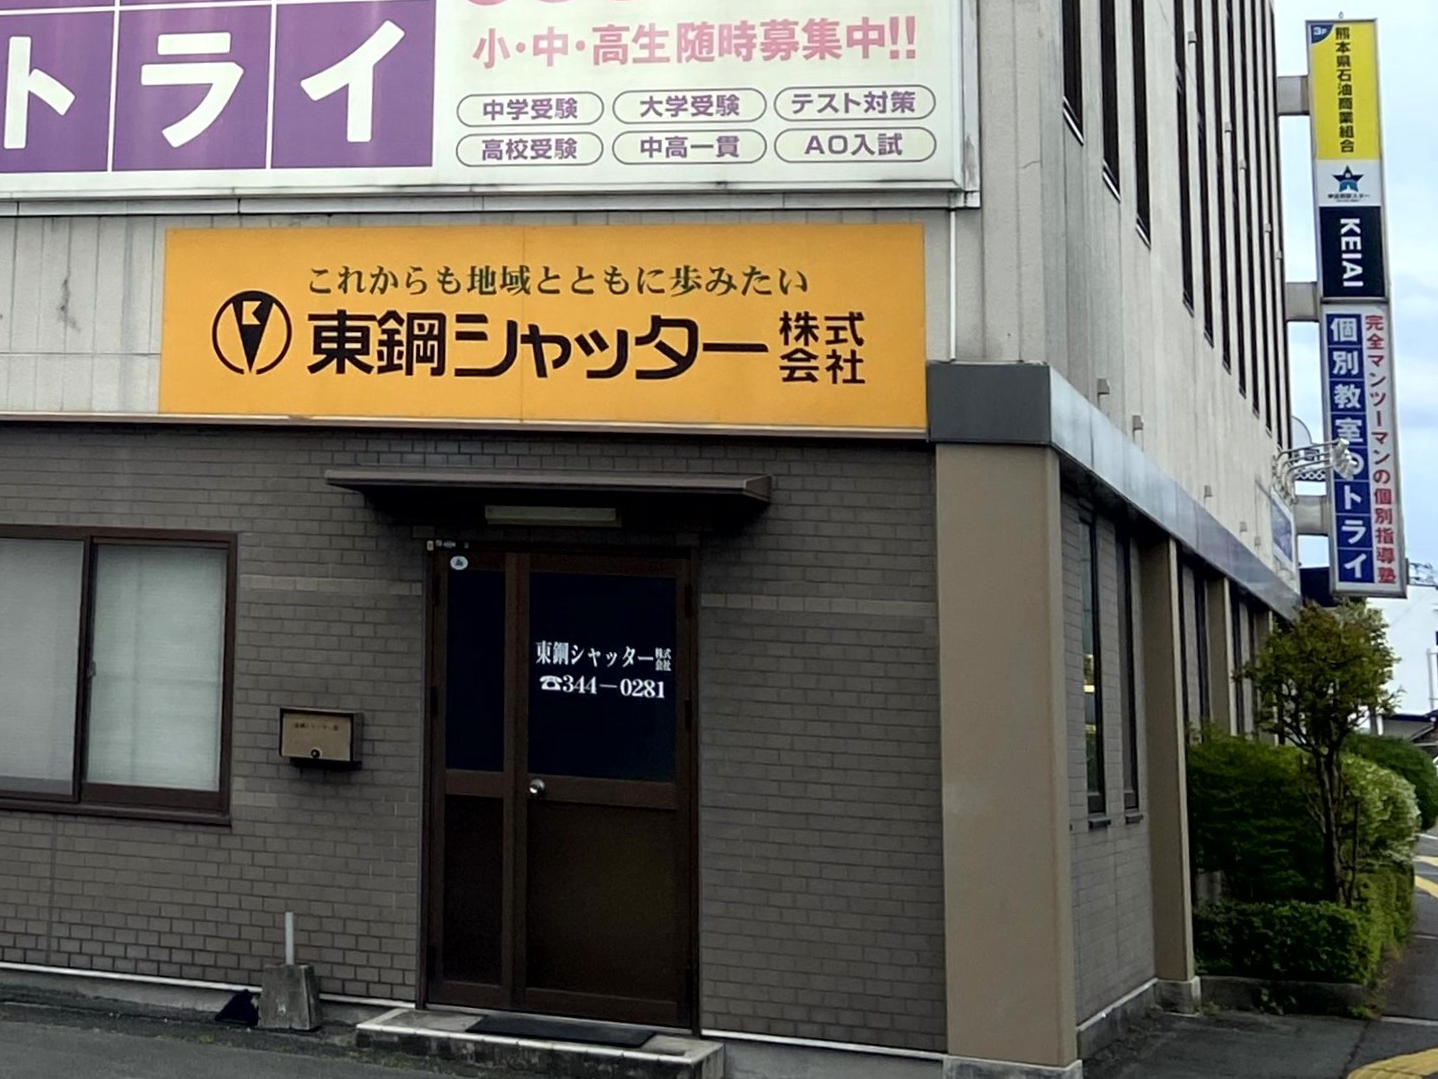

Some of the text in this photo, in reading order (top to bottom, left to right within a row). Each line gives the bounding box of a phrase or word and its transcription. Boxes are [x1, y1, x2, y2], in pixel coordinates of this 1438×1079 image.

[482, 97, 578, 120] 中学受験
[640, 93, 741, 117] 大学受験
[792, 90, 916, 115] テスト対策
[481, 137, 578, 161] 高校受験
[640, 135, 740, 159] 中高一貫
[804, 133, 903, 157] AO入試
[1340, 218, 1364, 288] KEIAI
[308, 264, 809, 297] これからも地域とともに歩みたい
[306, 308, 769, 380] 東鋼シャッター
[562, 674, 665, 699] 344-0281
